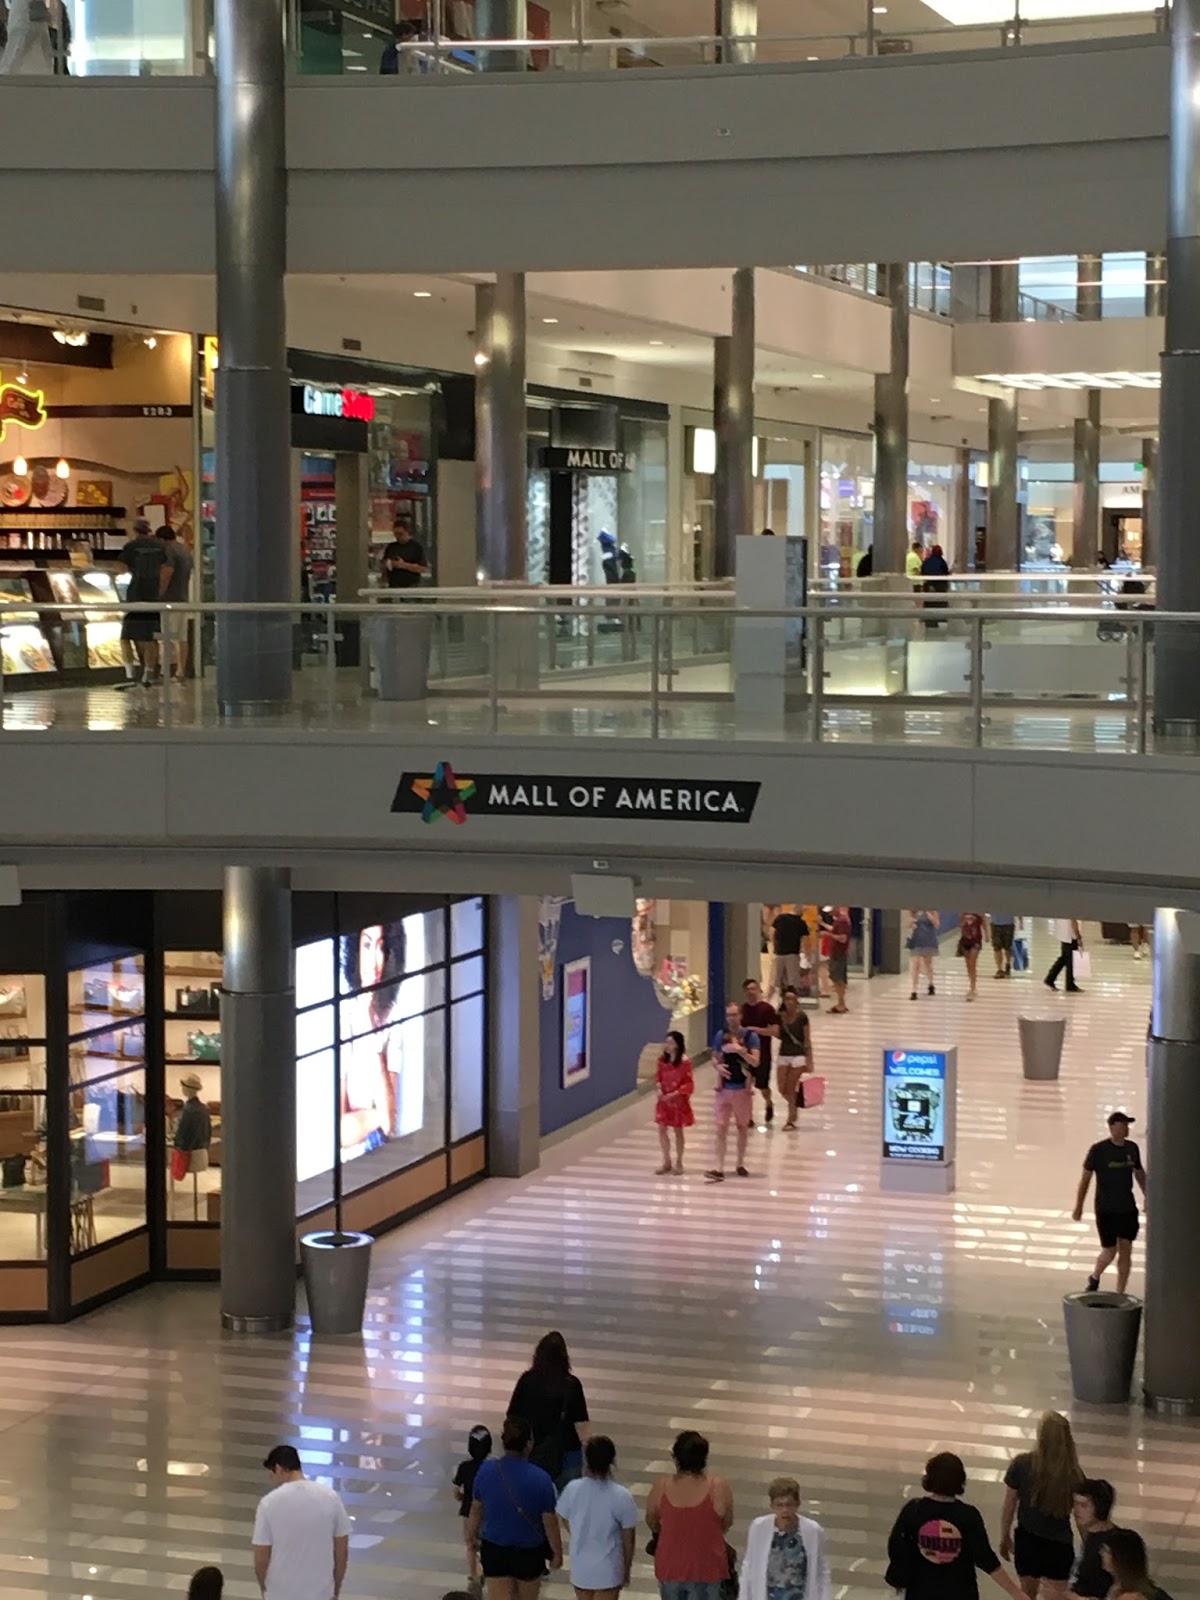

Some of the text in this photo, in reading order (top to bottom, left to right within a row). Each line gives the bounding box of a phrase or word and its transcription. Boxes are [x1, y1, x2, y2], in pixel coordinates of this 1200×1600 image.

[567, 450, 606, 469] MALL
[488, 784, 740, 813] MALL OF AMERICA
